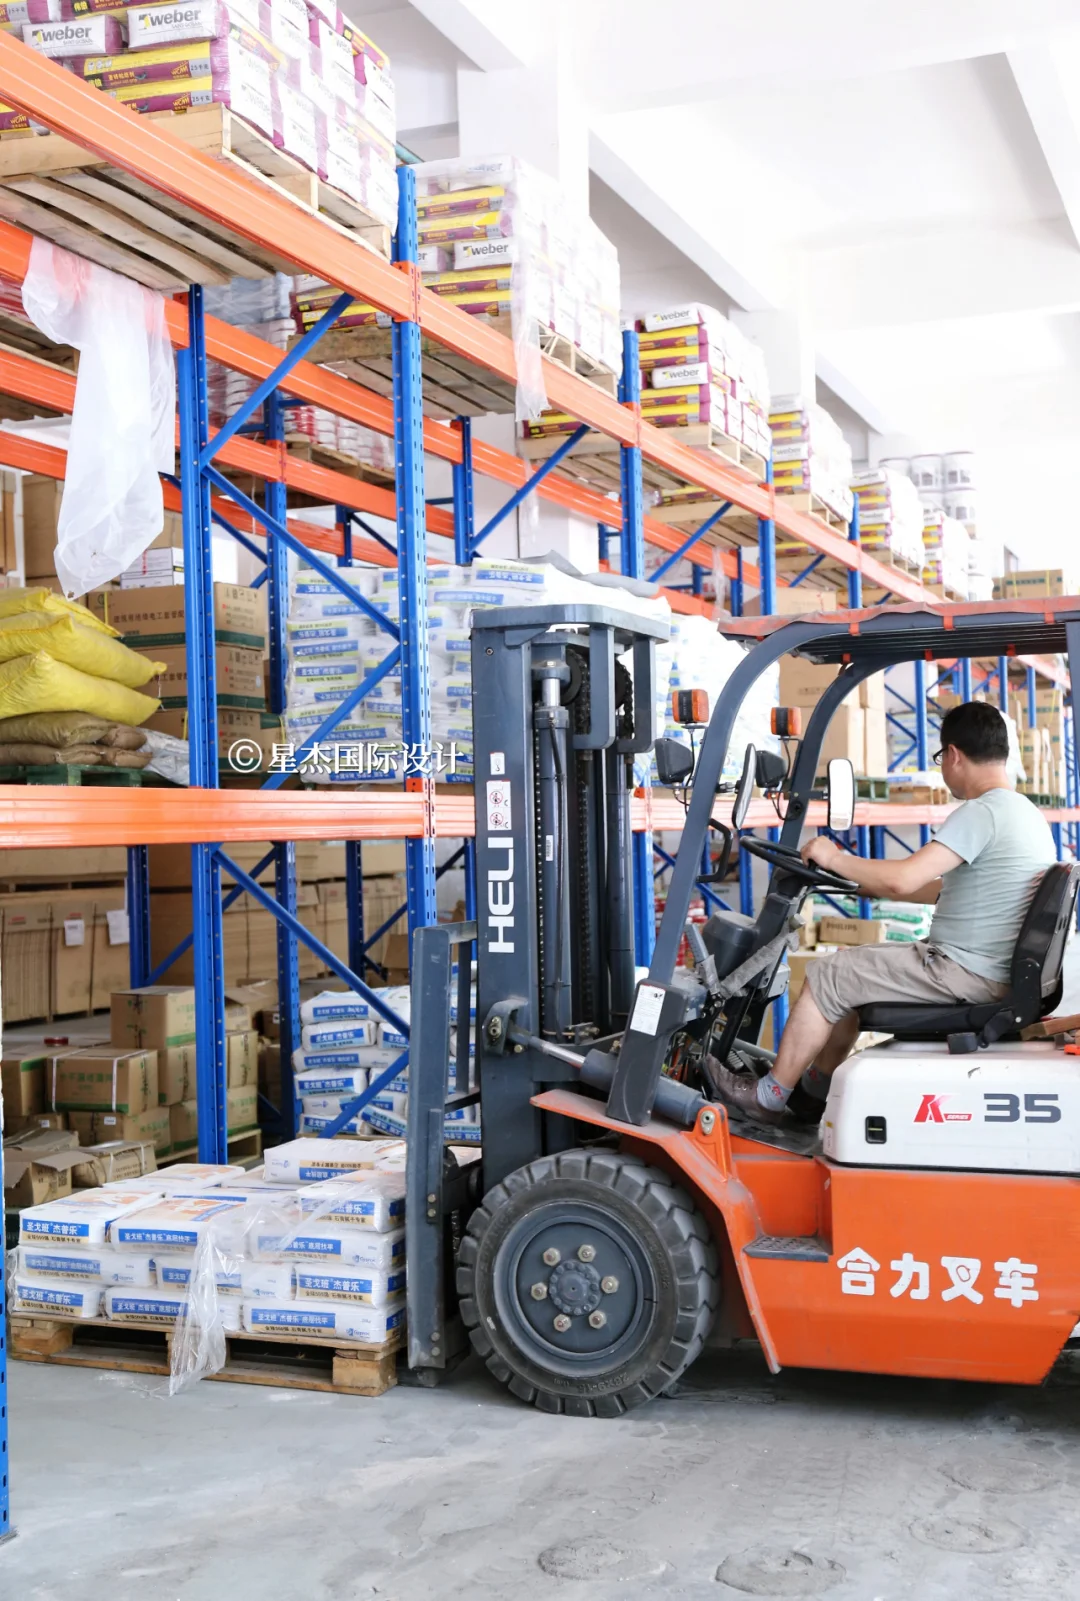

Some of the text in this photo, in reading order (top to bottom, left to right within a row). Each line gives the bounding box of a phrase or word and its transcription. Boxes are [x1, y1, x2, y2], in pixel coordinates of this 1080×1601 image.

[151, 9, 202, 26] weber
[42, 26, 92, 42] weber
[472, 243, 509, 256] weber
[661, 309, 690, 321] weber
[670, 369, 700, 382] weber
[488, 837, 514, 953] HELI
[914, 1093, 1062, 1124] K 35
[837, 1246, 1040, 1308] 合力叉车
